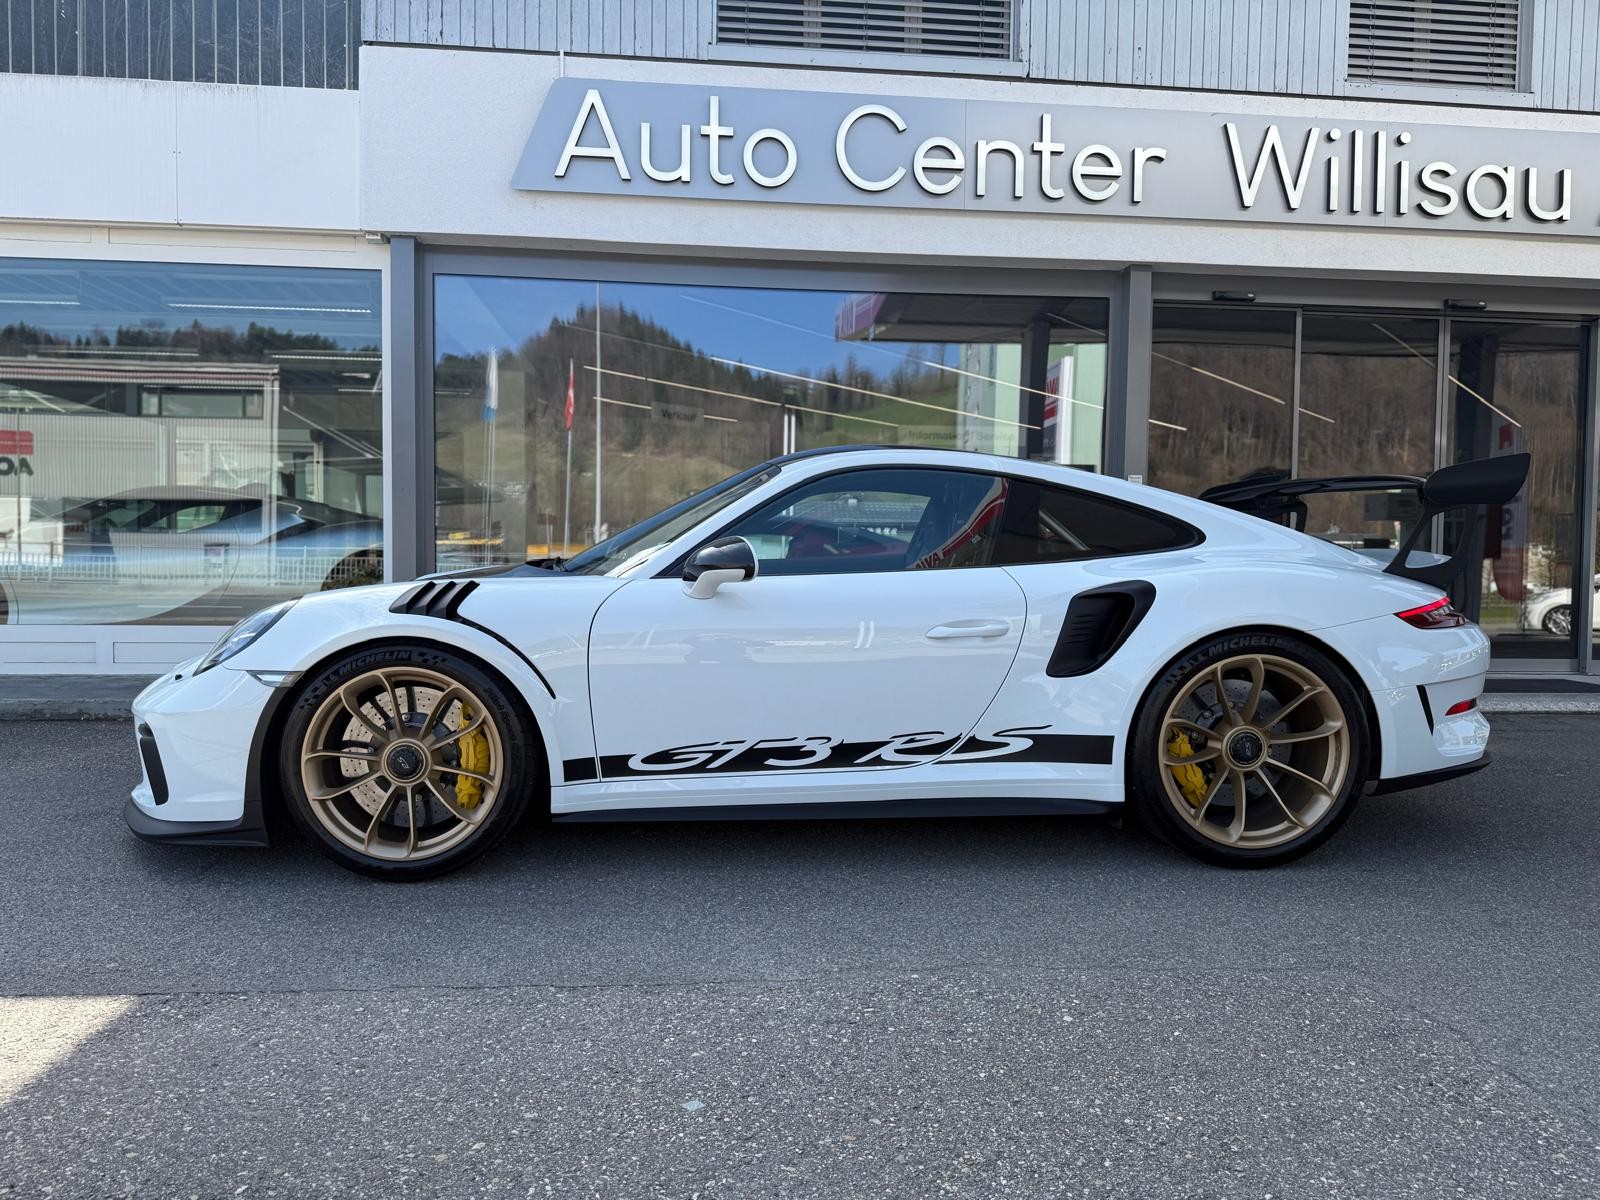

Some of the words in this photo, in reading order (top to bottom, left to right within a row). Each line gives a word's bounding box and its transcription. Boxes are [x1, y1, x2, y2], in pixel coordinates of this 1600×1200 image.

[554, 88, 798, 188] Auto
[835, 103, 1167, 203] Center
[1225, 122, 1571, 222] Willisau
[339, 651, 412, 675] MICHELIN
[627, 736, 838, 771] GT3
[853, 724, 1054, 764] RS
